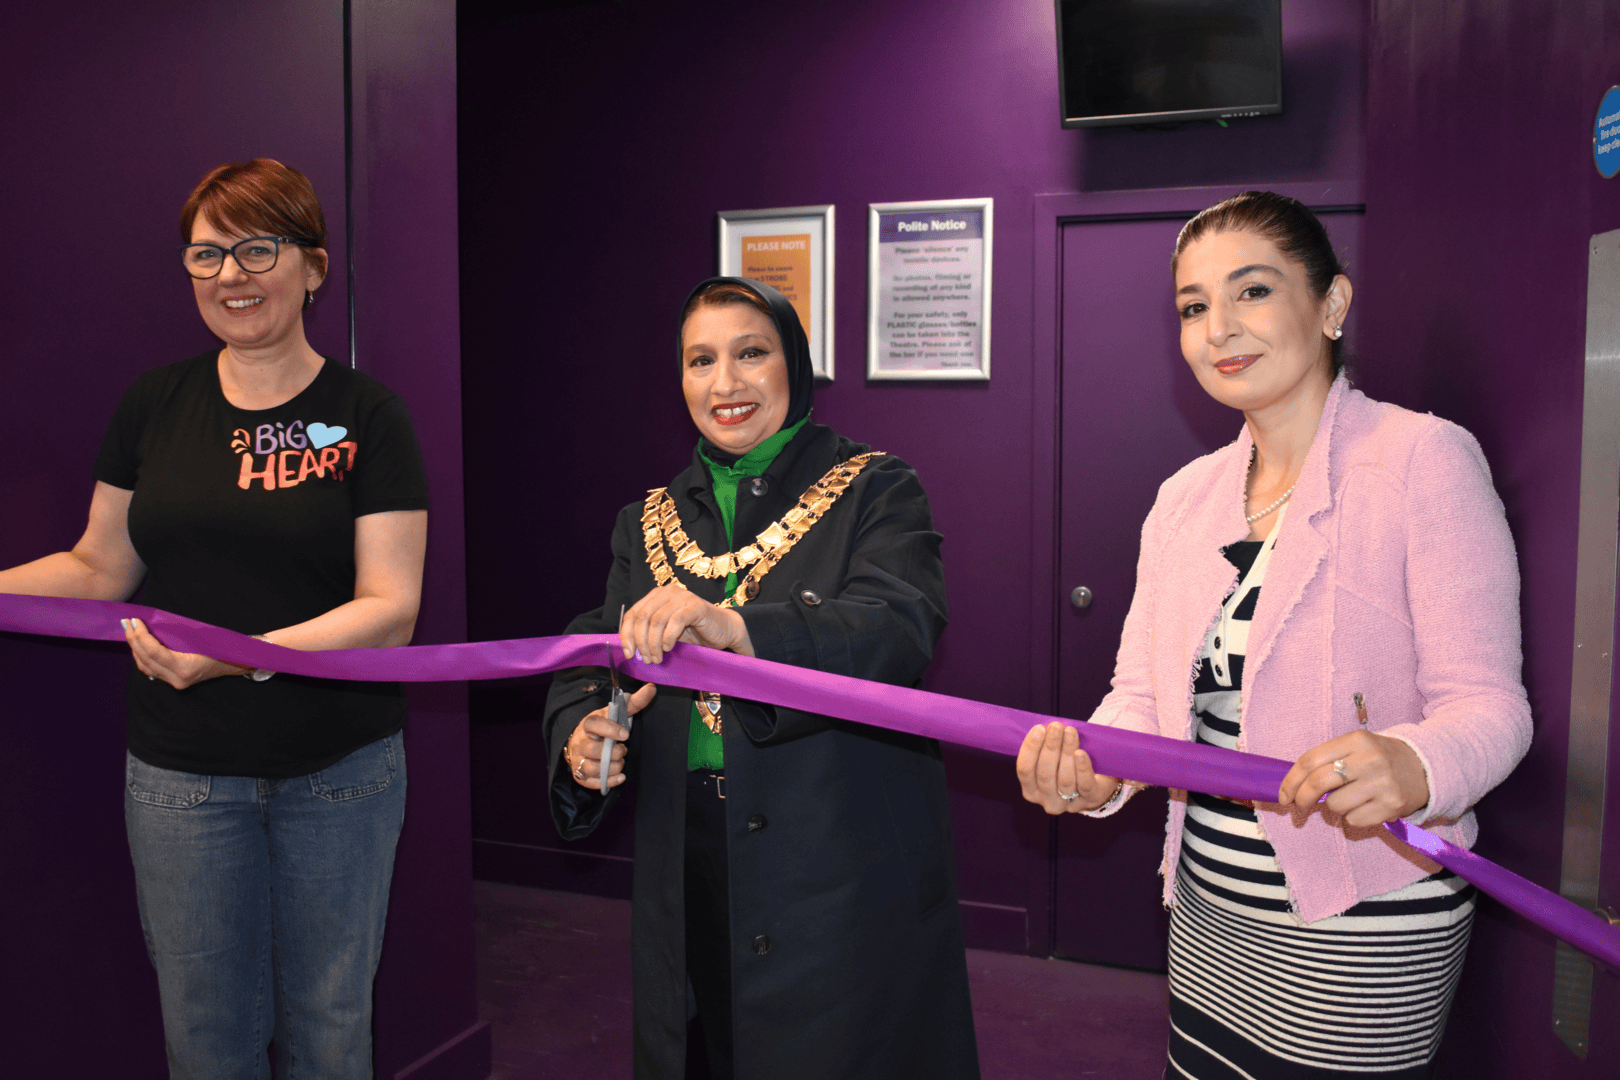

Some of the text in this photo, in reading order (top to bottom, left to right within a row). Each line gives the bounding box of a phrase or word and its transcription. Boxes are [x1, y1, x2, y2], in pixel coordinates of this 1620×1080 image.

[898, 219, 967, 232] Polite Notice
[747, 240, 805, 251] PLEASE NOTE
[886, 321, 916, 329] PLASTIC
[237, 441, 358, 491] HEART
